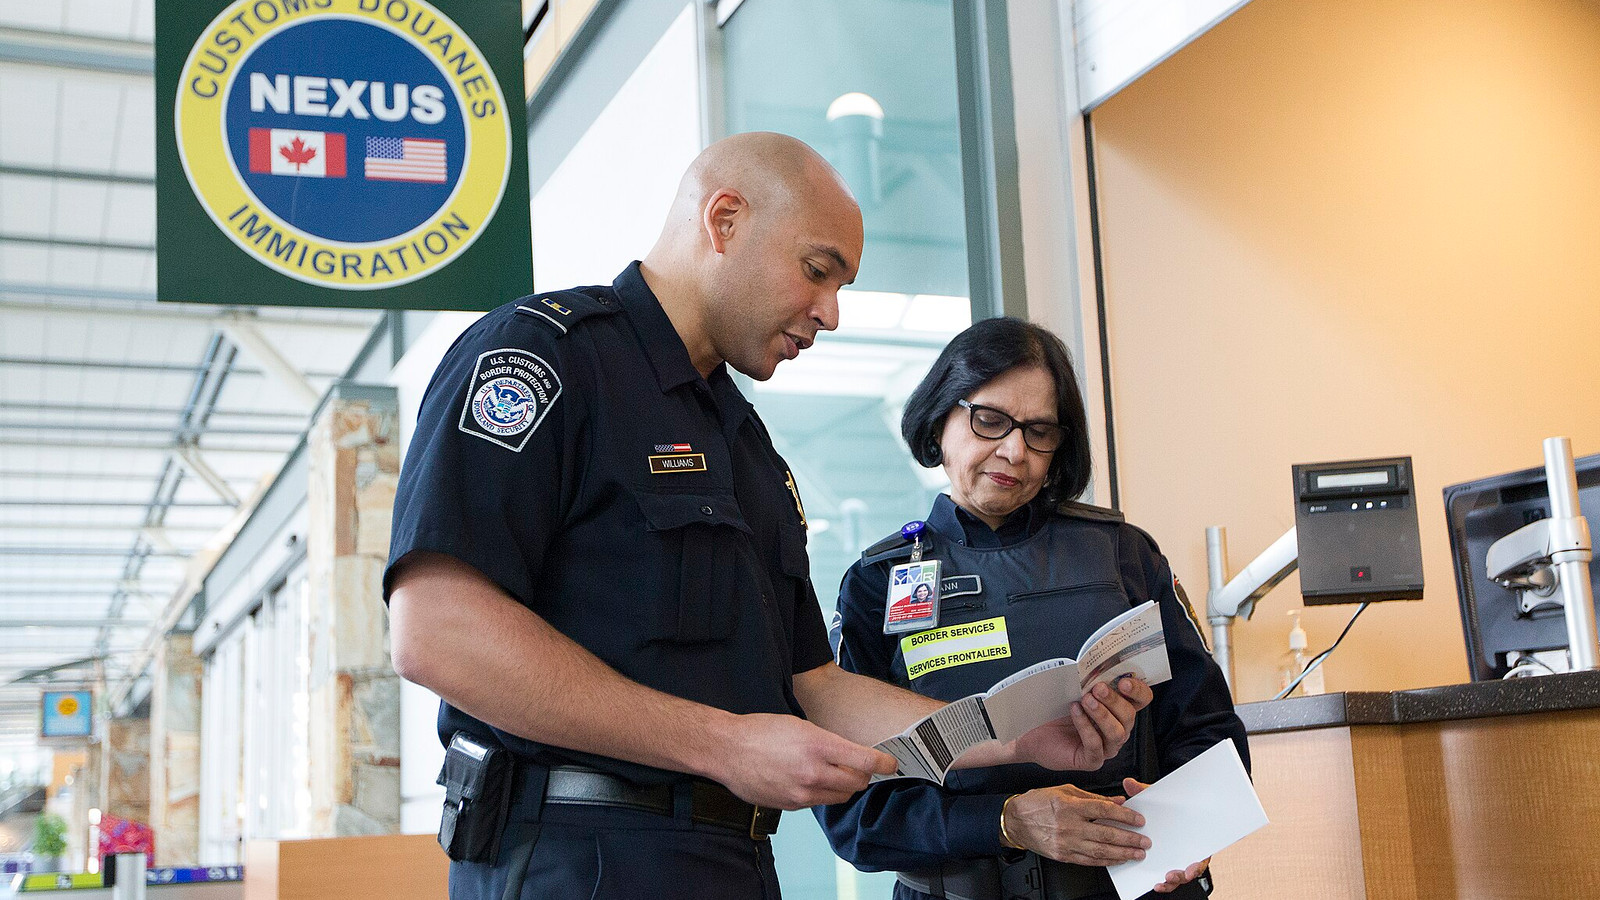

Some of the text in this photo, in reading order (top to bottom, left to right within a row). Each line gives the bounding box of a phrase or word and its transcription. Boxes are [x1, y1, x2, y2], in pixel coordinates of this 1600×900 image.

[250, 72, 447, 125] NEXUS
[228, 203, 471, 279] IMMIGRATION
[490, 356, 506, 366] U.S.
[508, 355, 546, 378] CUSTOMS
[479, 366, 549, 405] BORDER PROTECTION
[496, 379, 533, 403] DEPARTMENT
[474, 400, 530, 434] HOMELAND SECURITY
[661, 458, 694, 468] WILLIAMS
[894, 572, 935, 585] YVR
[911, 622, 995, 647] BORDER SERVICES
[909, 646, 1008, 676] SERVICES FRONTALIERS
